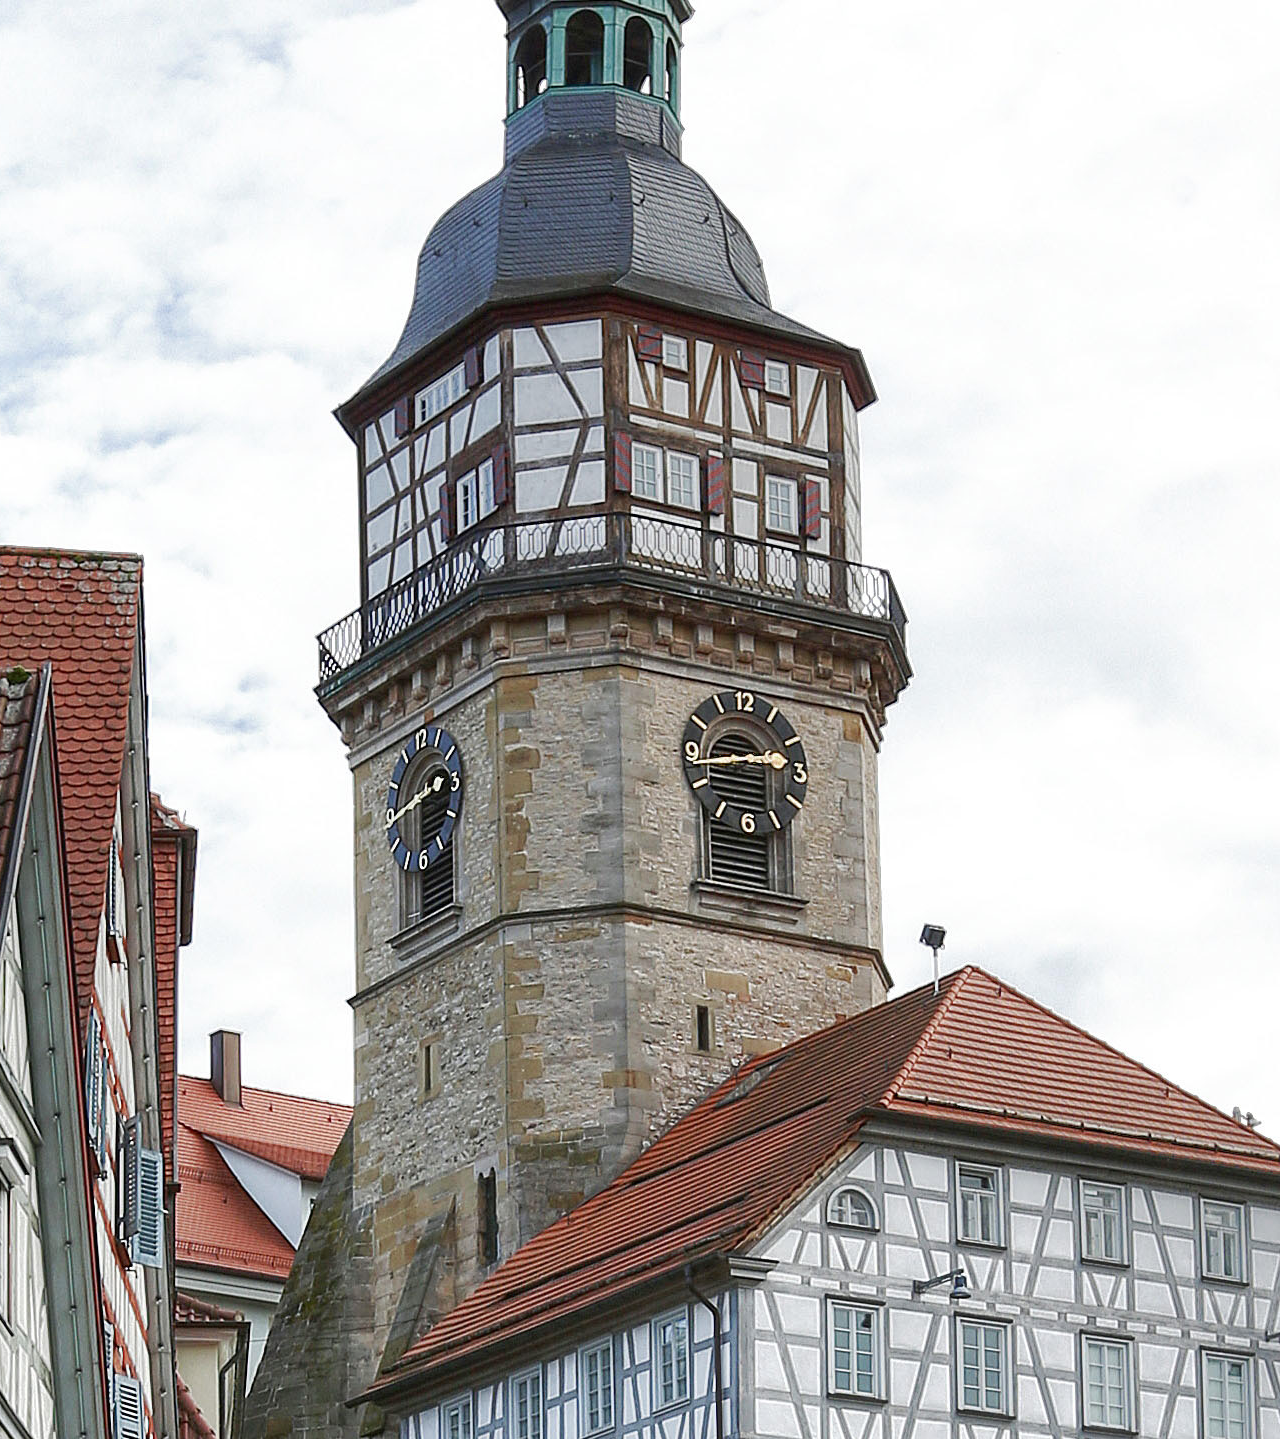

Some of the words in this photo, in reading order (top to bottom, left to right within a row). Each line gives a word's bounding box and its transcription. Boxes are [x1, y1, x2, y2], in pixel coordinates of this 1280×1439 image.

[734, 691, 755, 712] 12
[415, 728, 427, 751] 12
[684, 741, 700, 762] 9
[450, 770, 460, 792] 3
[792, 762, 807, 784] 3
[740, 812, 756, 833] 6
[418, 849, 429, 870] 6
